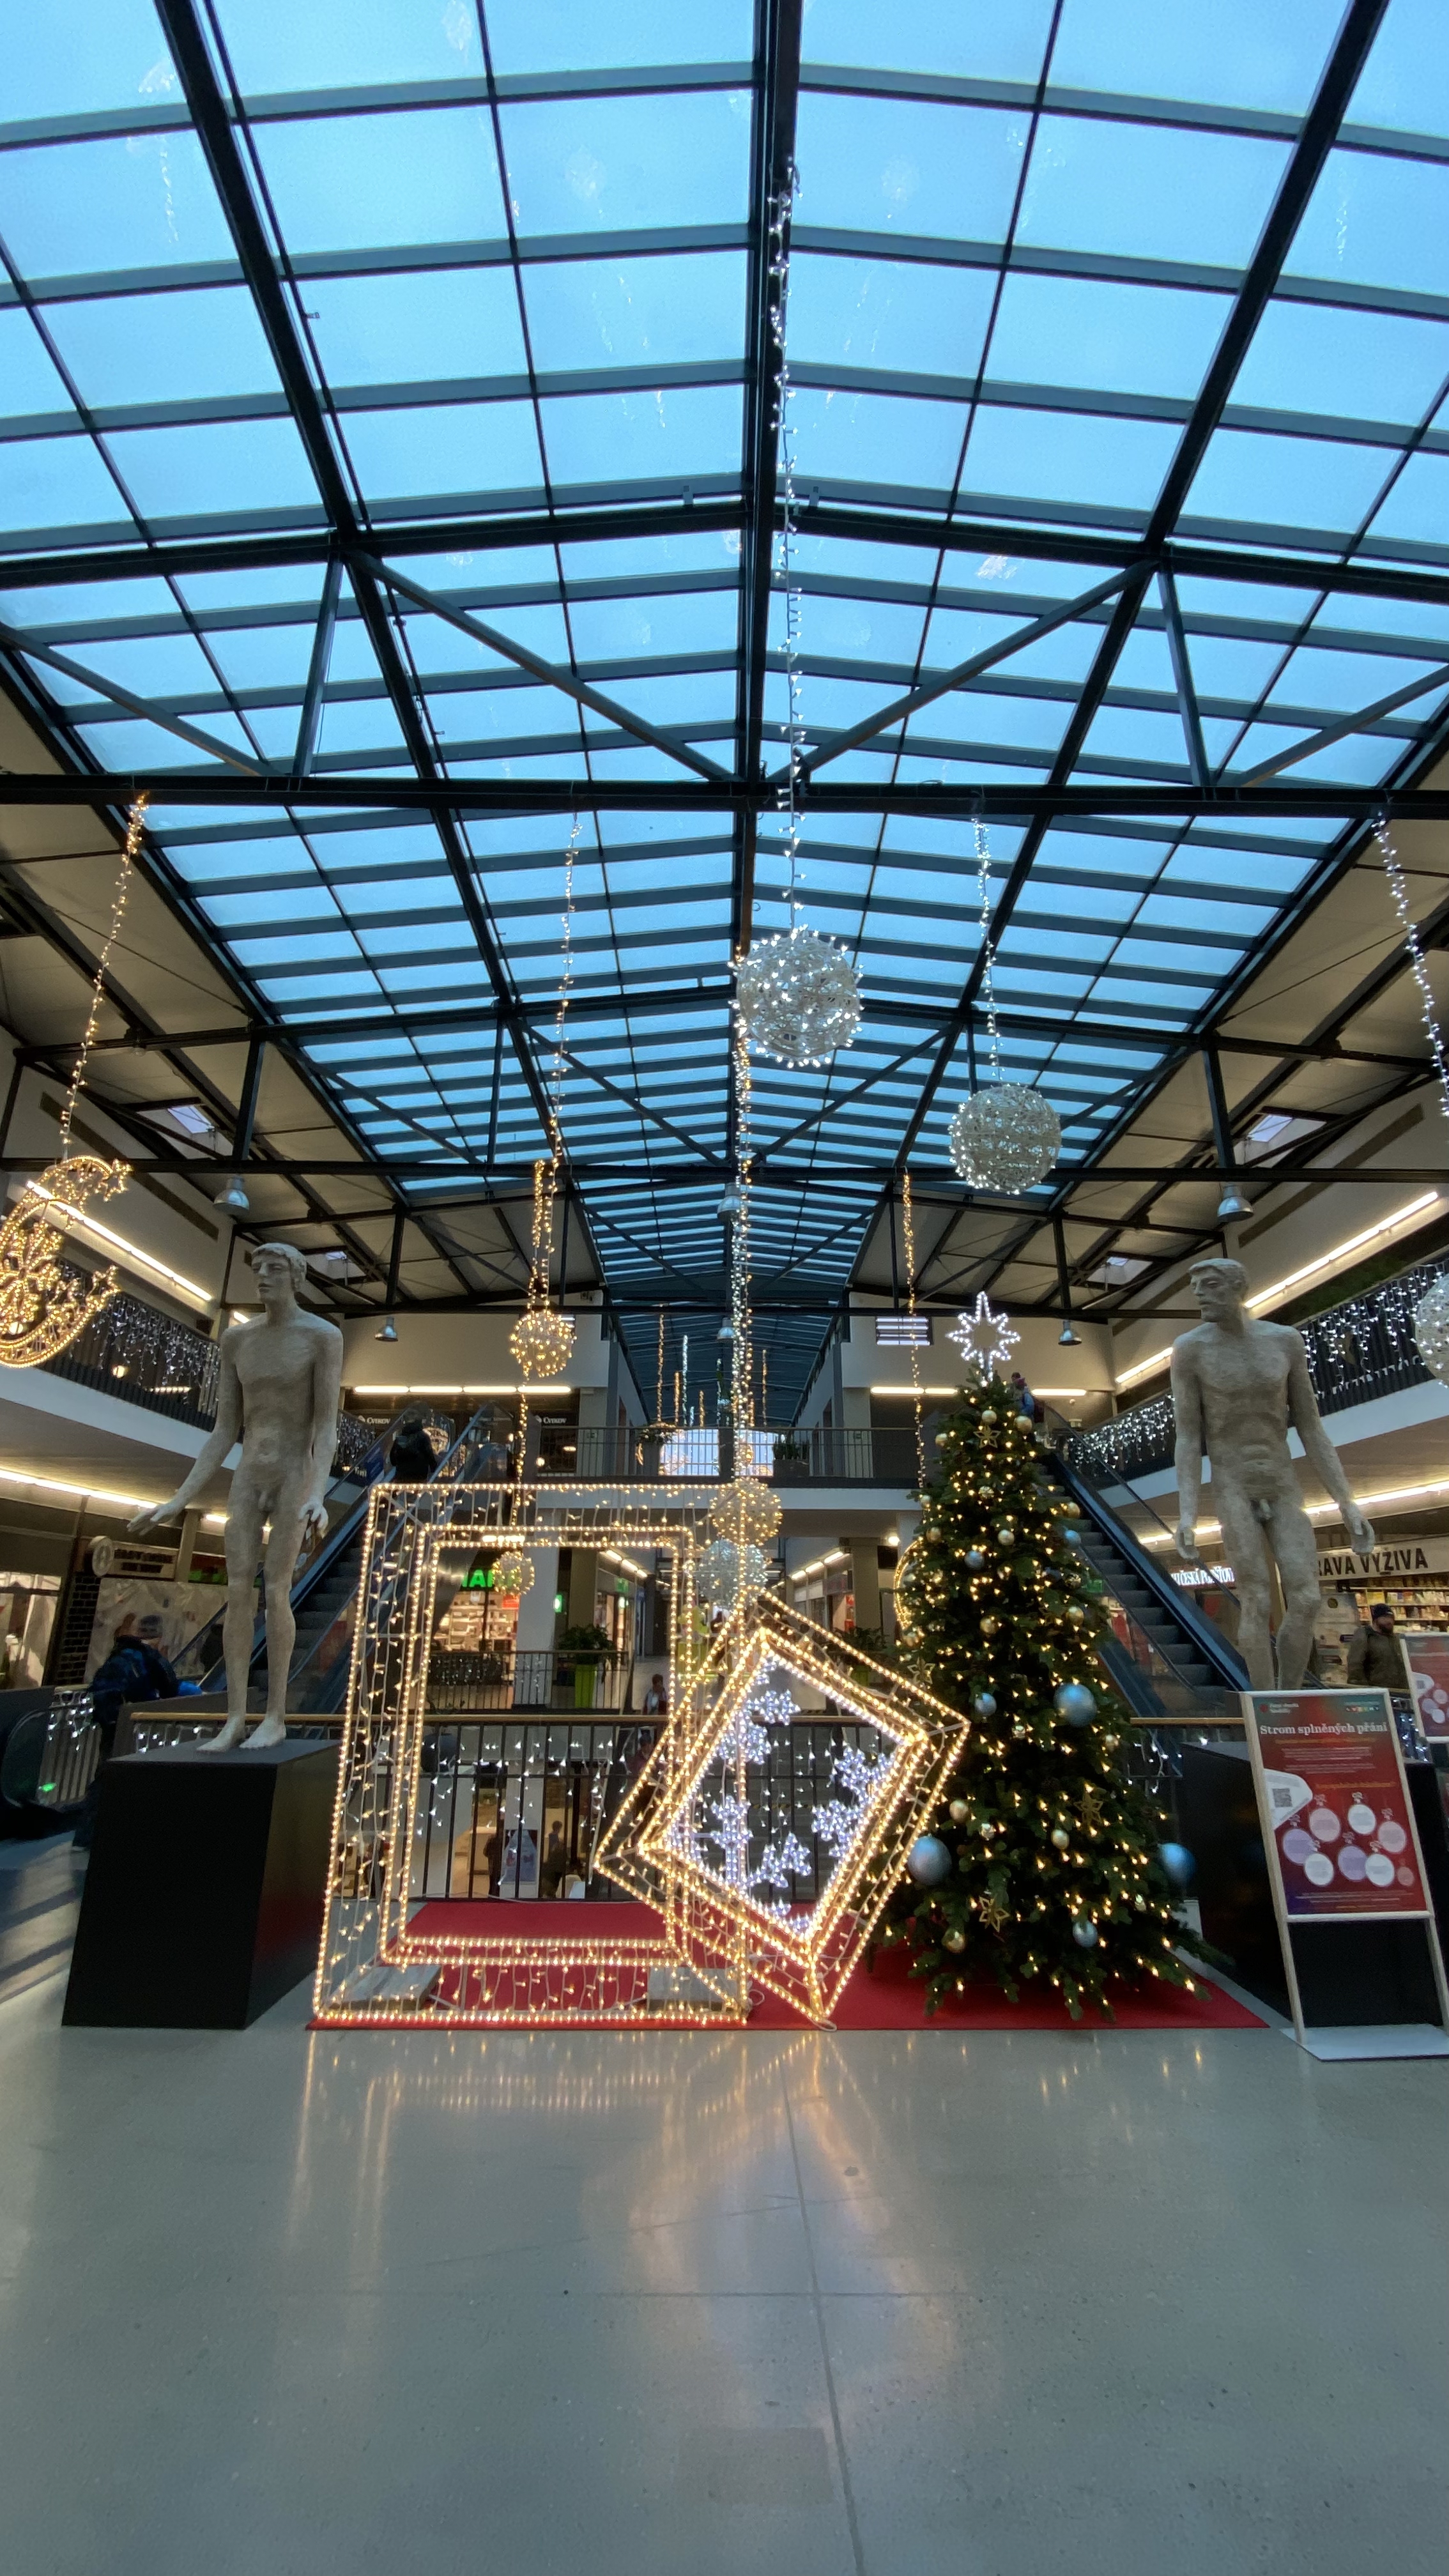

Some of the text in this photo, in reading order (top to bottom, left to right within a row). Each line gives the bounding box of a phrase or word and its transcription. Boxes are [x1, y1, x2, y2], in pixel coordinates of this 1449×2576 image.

[1260, 1722, 1388, 1736] Strom splněných přání
